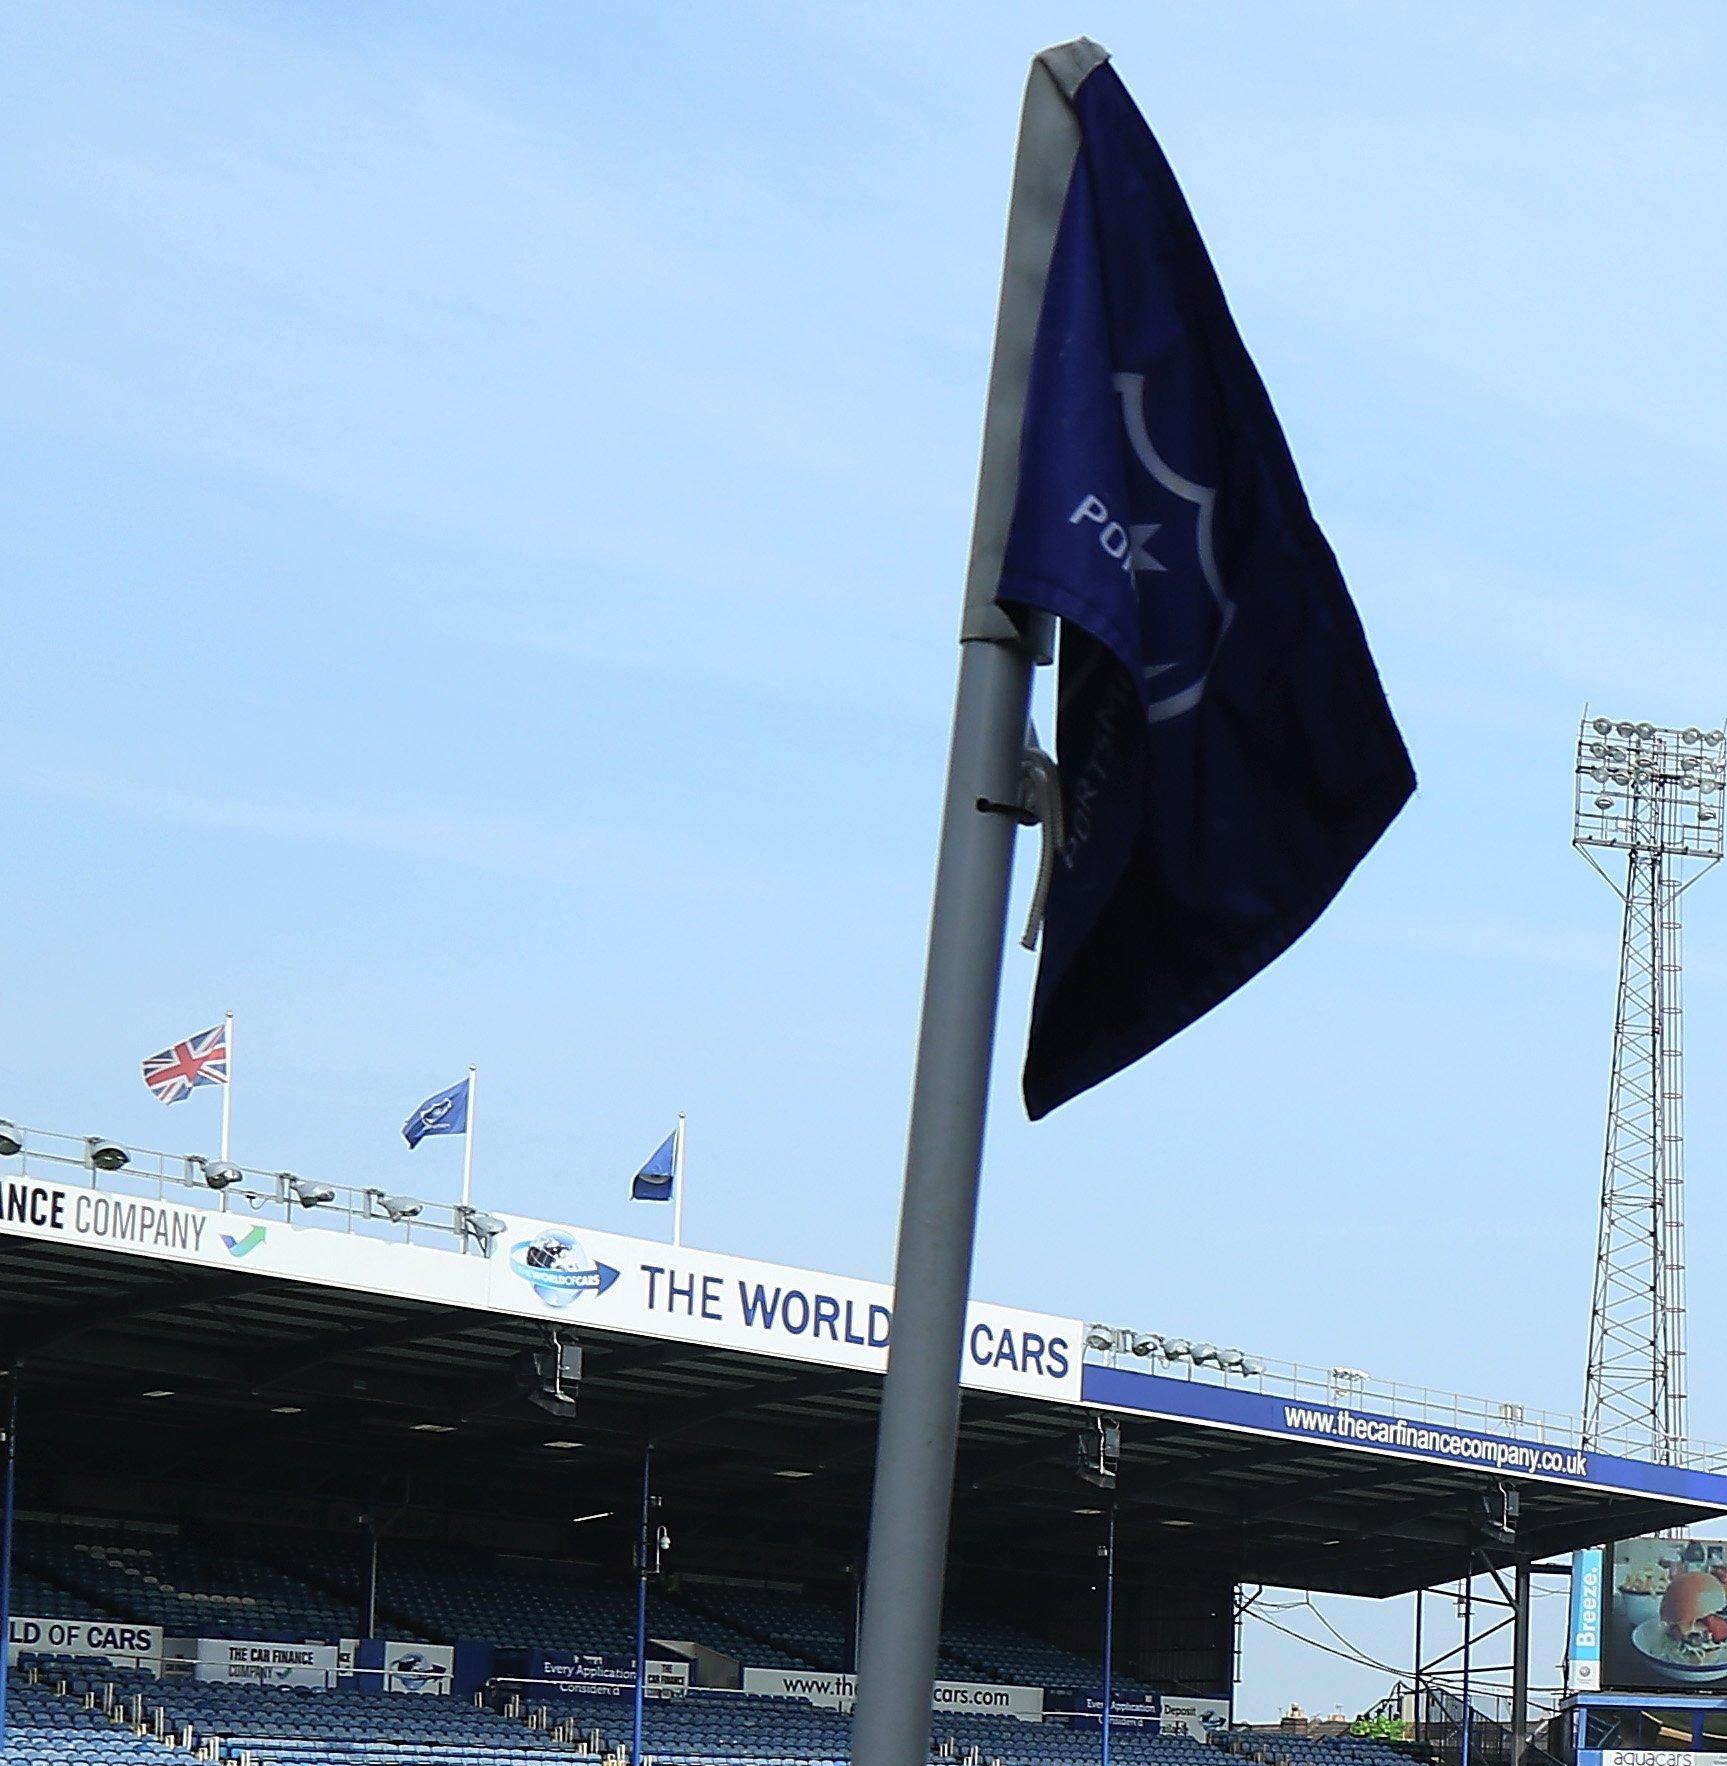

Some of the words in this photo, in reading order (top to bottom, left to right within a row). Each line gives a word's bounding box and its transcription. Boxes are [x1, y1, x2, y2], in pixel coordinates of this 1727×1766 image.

[0, 1181, 66, 1230] NCE
[76, 1195, 207, 1252] COMPANY
[641, 1264, 724, 1321] THE
[738, 1280, 892, 1349] WORLD
[970, 1323, 1069, 1379] CARS
[1284, 1406, 1587, 1477] www.thecarfinancecompany.co.uk
[1574, 1566, 1599, 1648] Breeze.
[48, 1624, 80, 1646] OF
[87, 1626, 151, 1651] CARS
[229, 1647, 247, 1662] THE
[250, 1649, 270, 1663] CAR
[272, 1650, 314, 1665] FINANCE
[543, 1661, 576, 1678] Every
[575, 1665, 637, 1680] Application
[933, 1687, 1010, 1706] cars.com
